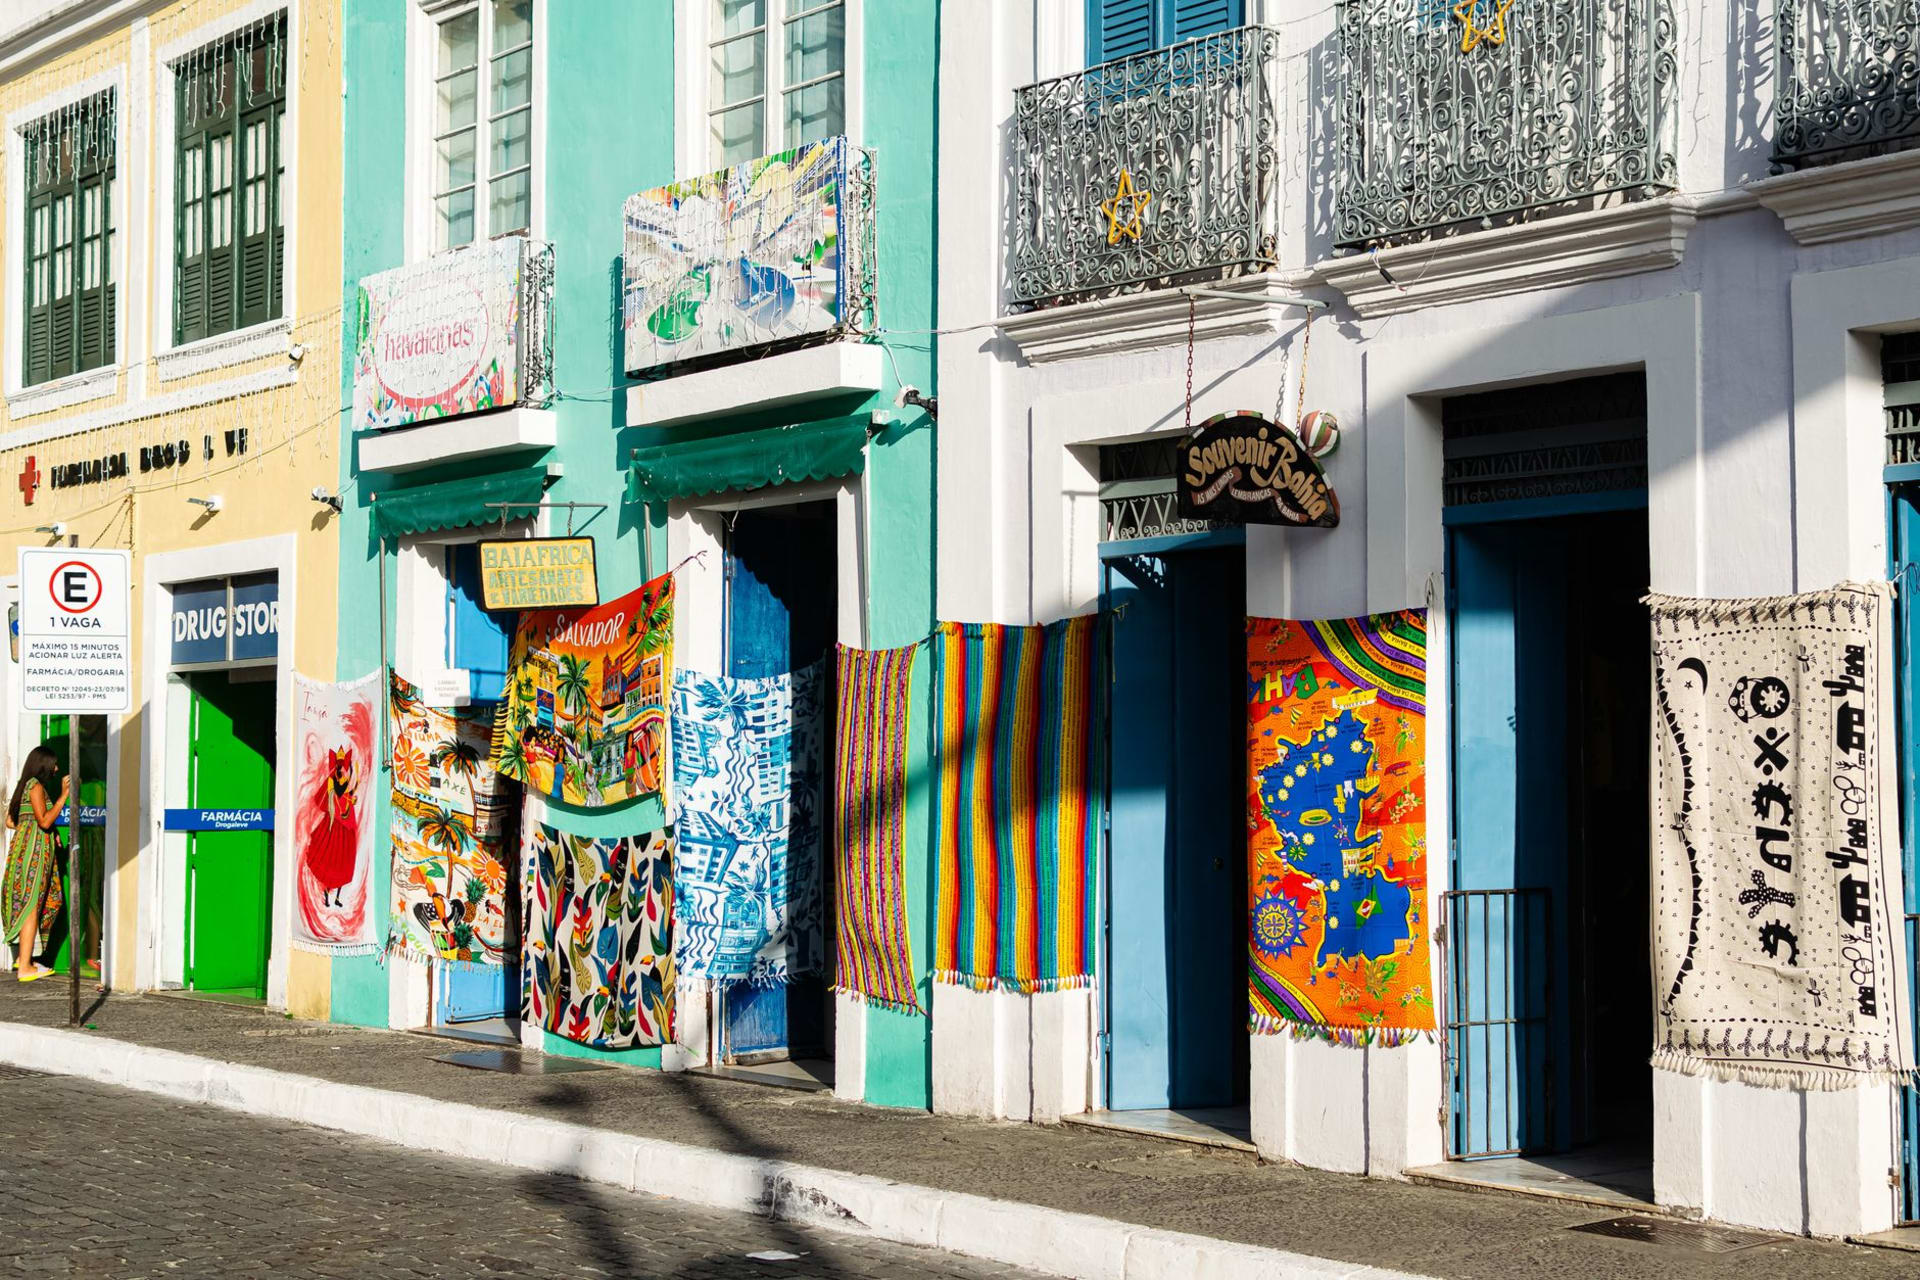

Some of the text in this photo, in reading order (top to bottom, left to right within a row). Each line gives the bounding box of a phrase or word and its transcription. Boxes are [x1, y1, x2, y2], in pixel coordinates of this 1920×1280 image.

[1185, 427, 1328, 520] Souvenir Bahia
[1231, 488, 1272, 502] LEMBRANÇAS
[1282, 505, 1300, 522] BAHIA
[483, 545, 594, 569] BAIAFRICA
[63, 572, 89, 603] E
[50, 617, 102, 628] 1 VAGA
[174, 601, 280, 643] DRUG STOR
[32, 642, 68, 651] MÁXIMO
[70, 643, 79, 651] 15
[71, 652, 88, 660] LUZ
[1248, 664, 1320, 704] BAHIA
[60, 806, 107, 817] ARÁCIA
[201, 810, 263, 822] FARMÁCIA
